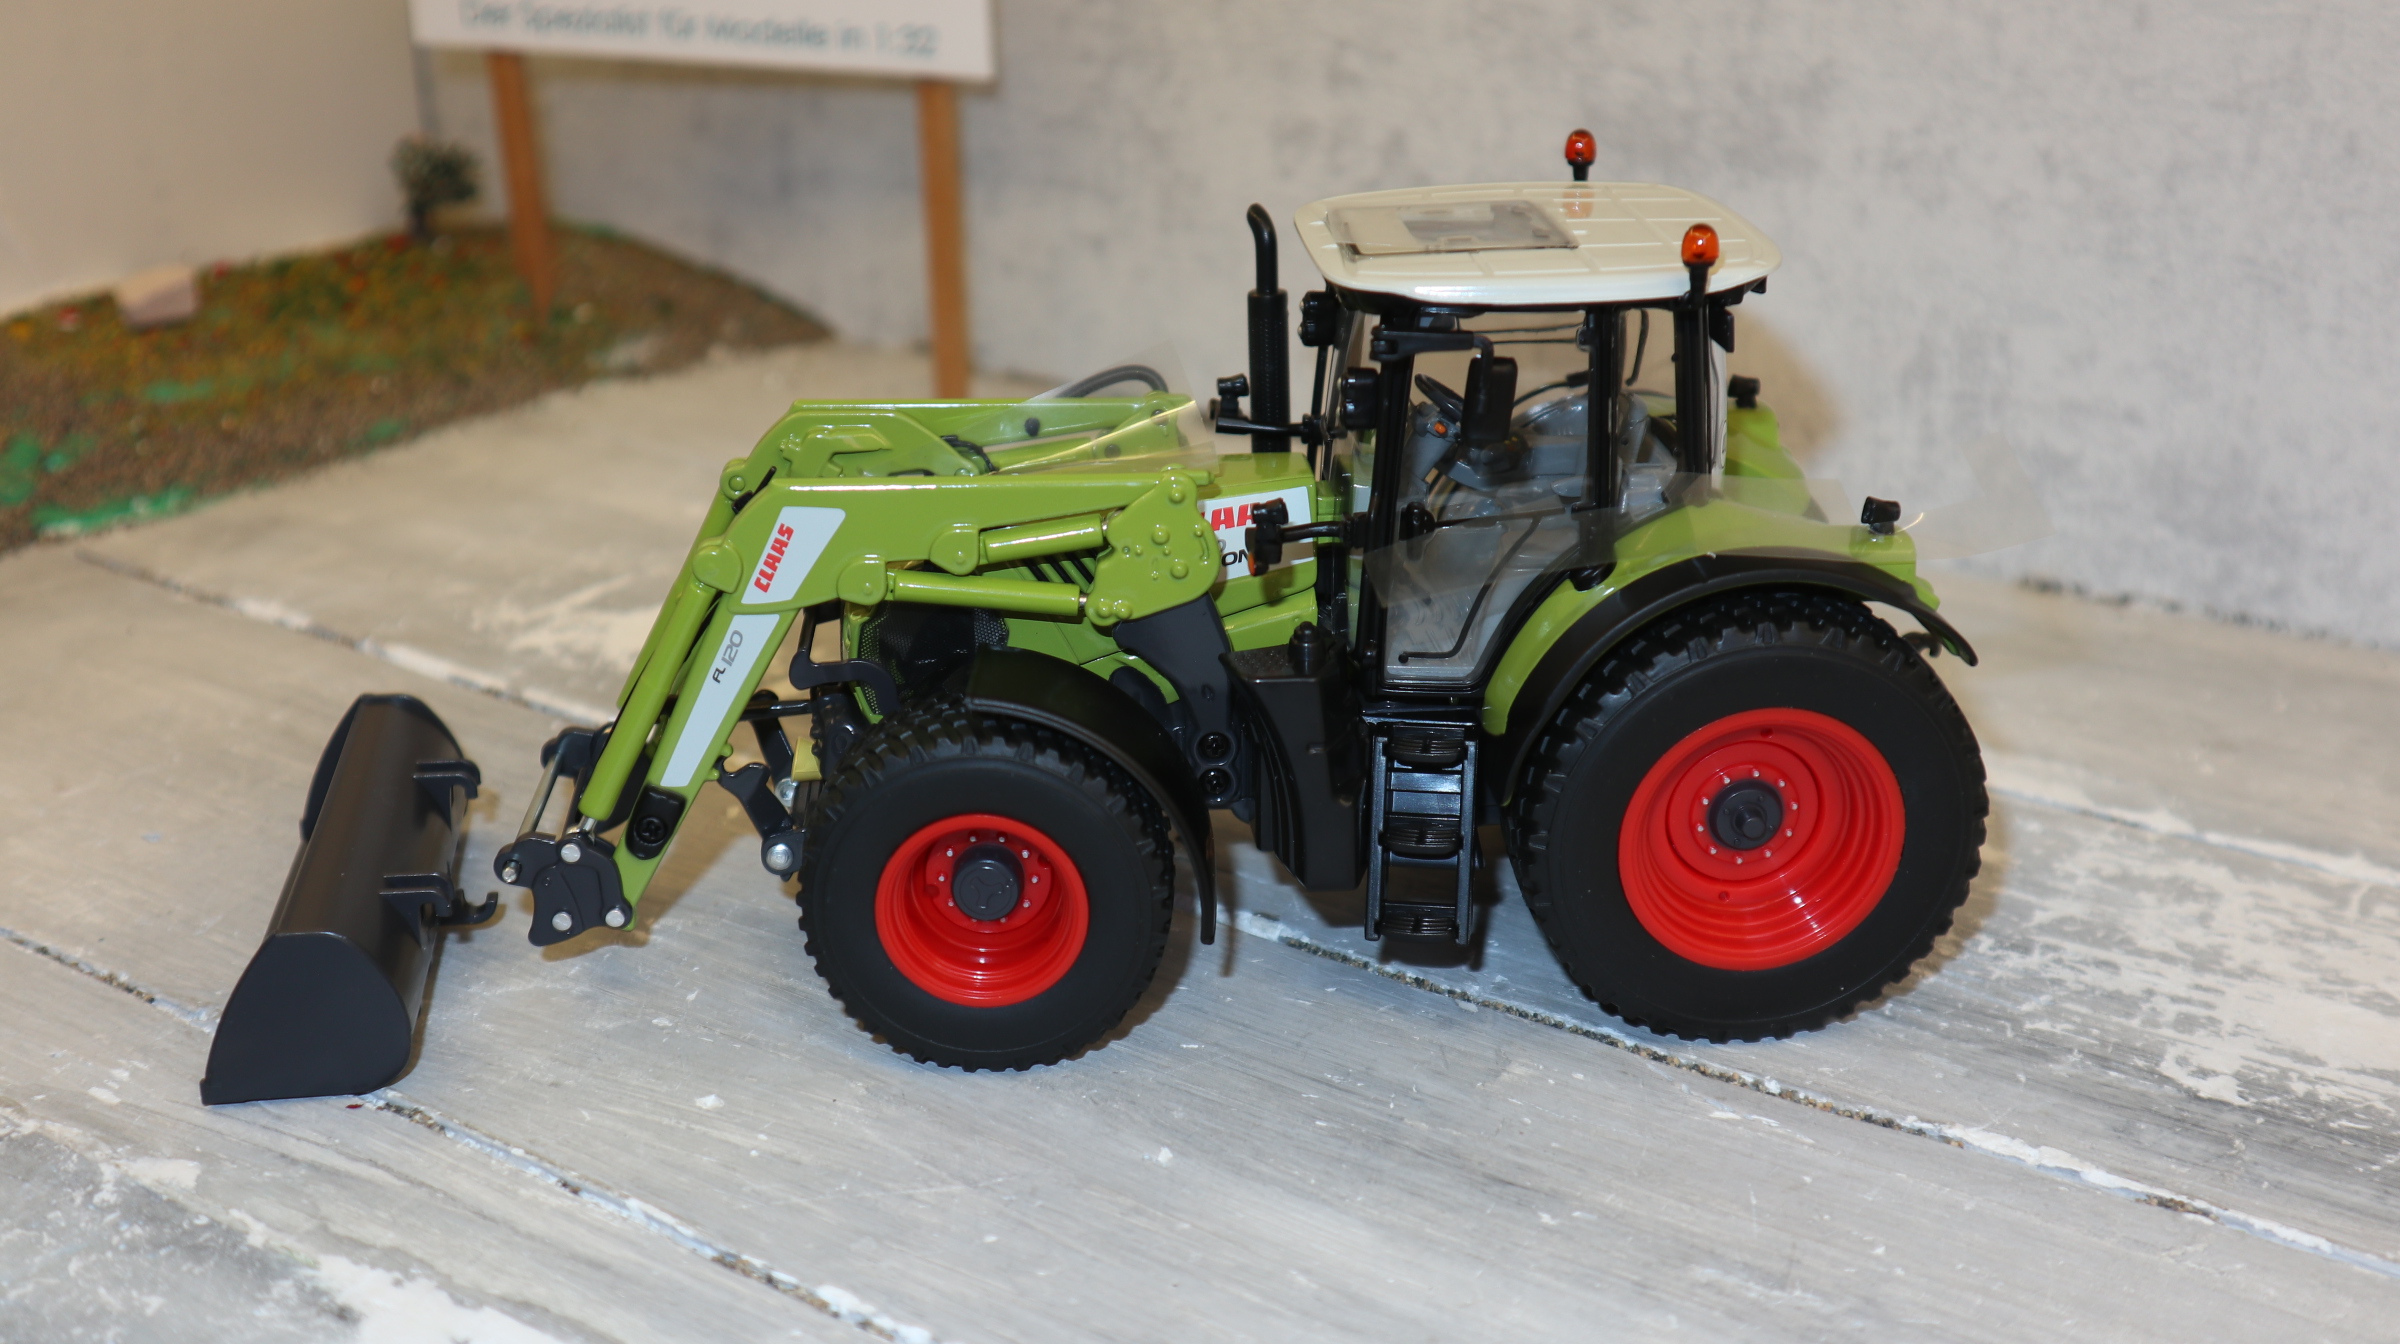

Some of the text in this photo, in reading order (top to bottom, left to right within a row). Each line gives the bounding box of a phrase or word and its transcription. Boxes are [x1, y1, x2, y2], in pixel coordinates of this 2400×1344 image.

[874, 21, 939, 58] 1:32
[753, 523, 794, 594] CLAAS
[712, 629, 744, 684] FL 120
